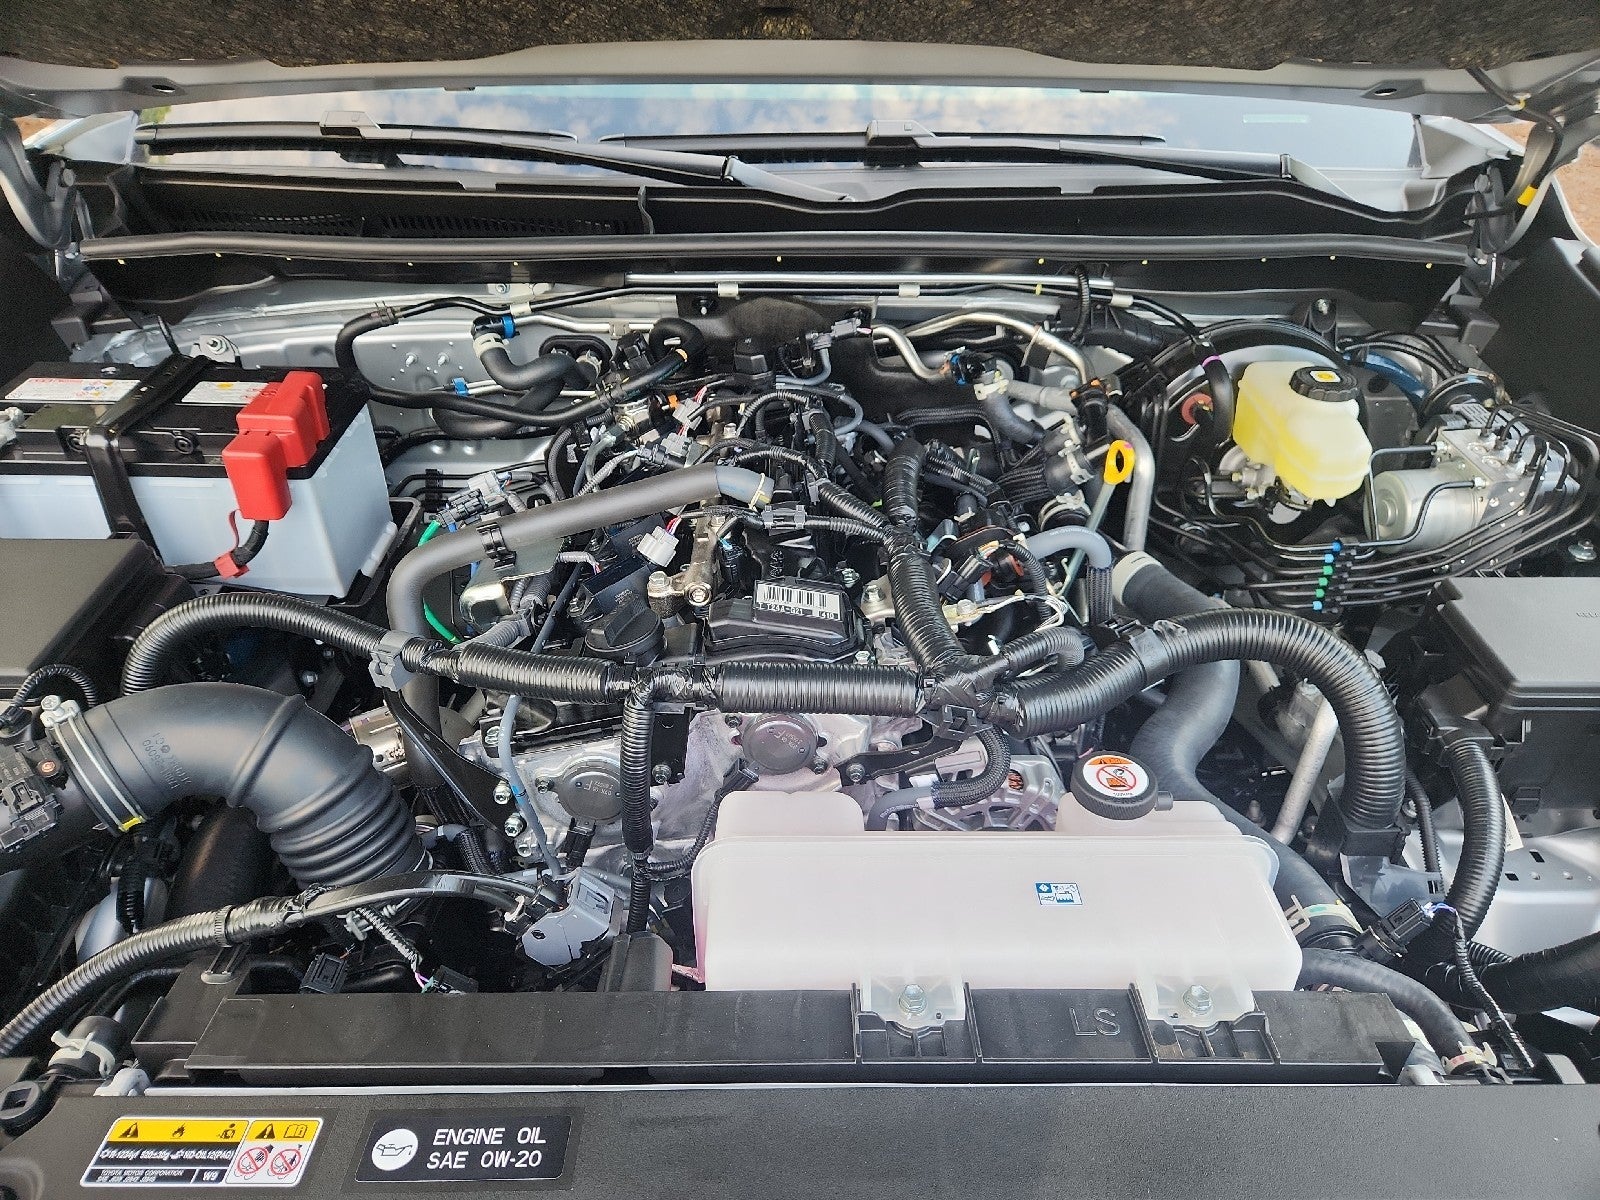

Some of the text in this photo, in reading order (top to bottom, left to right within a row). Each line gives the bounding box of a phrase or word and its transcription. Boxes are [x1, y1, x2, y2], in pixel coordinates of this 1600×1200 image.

[1069, 1006, 1120, 1036] LS
[432, 1126, 546, 1146] ENGINE OIL
[426, 1150, 542, 1169] SAE 0W-20
[100, 1168, 124, 1177] TOYOTA
